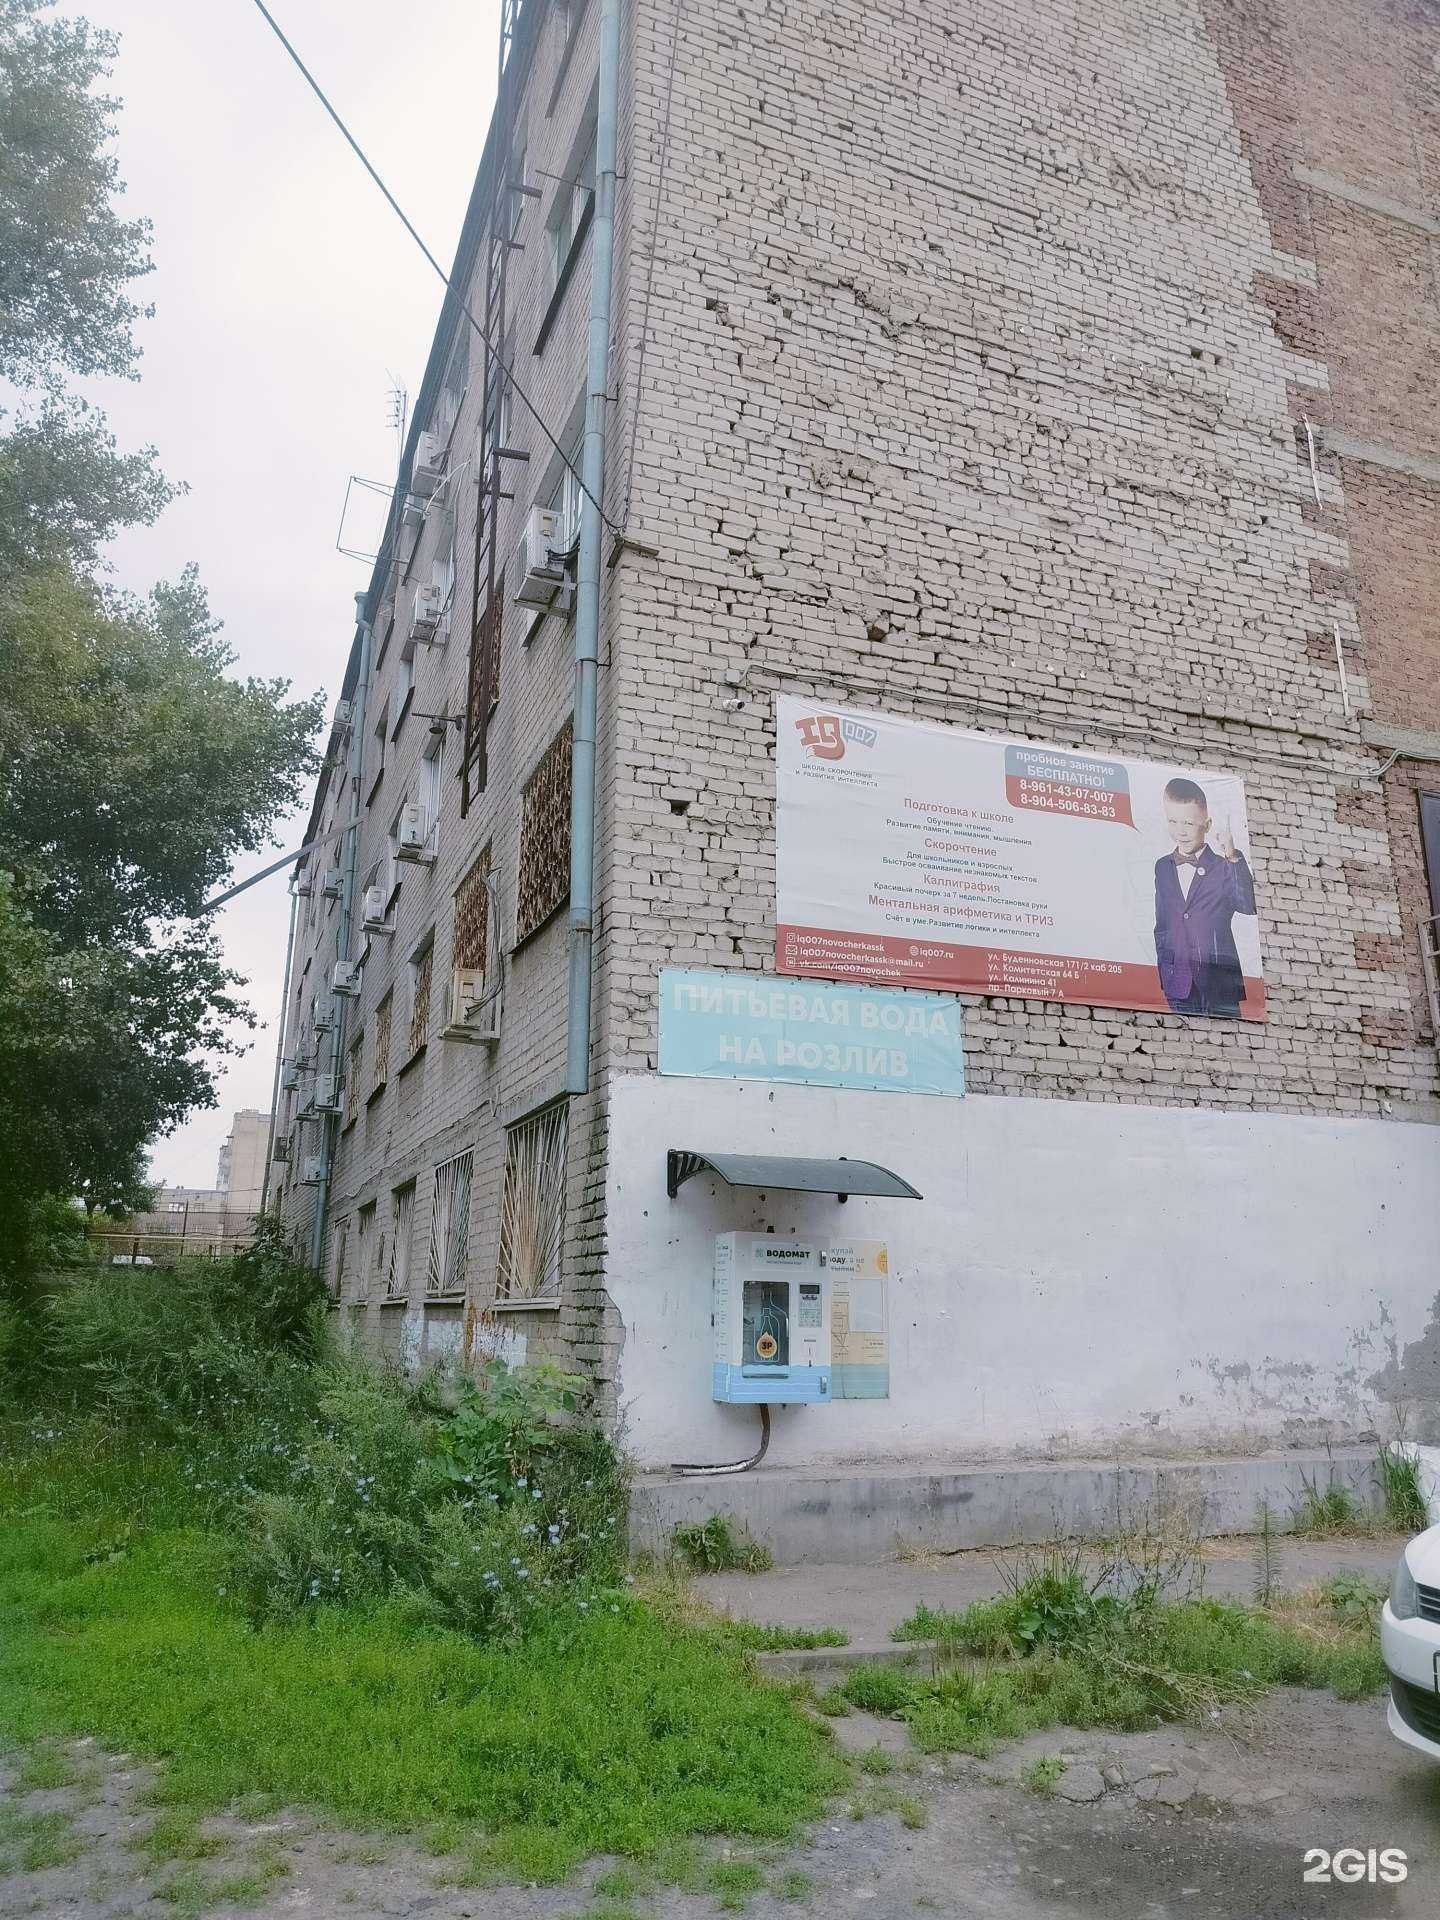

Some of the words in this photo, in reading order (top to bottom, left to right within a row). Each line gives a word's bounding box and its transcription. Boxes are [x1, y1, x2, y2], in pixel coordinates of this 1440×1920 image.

[1016, 752, 1066, 767] пробное
[1070, 760, 1114, 776] занятие
[1027, 765, 1106, 788] БЕСПЛАТНО!
[1020, 779, 1114, 804] 8-961-43-07-007
[904, 798, 968, 817] Подготовка
[971, 810, 978, 818] к
[980, 812, 1014, 824] школе
[1020, 793, 1116, 818] 8-904-506-83-83
[886, 818, 921, 830] Развитие
[994, 835, 1032, 846] мышления
[926, 816, 963, 828] Обучение
[924, 838, 997, 857] Скорочтение
[882, 856, 917, 868] Быстрое
[964, 868, 1008, 879] незнакомых
[906, 851, 922, 860] Для
[924, 854, 969, 866] школьников
[978, 861, 1013, 872] взрослых
[914, 888, 941, 896] почерк
[924, 874, 1000, 894] Каллиграфия
[868, 894, 940, 912] Ментальная
[944, 906, 1012, 921] арифметика
[1024, 914, 1054, 926] ТРИЗ
[965, 924, 990, 932] логики
[999, 928, 1040, 938] интеллекта
[988, 953, 1000, 961] ул.
[1066, 960, 1089, 970] 171/2
[1090, 964, 1106, 972] каб
[1108, 965, 1122, 974] 205
[988, 964, 1000, 972] ул.
[1002, 964, 1061, 978] Комитетская
[988, 974, 1000, 982] ул.
[1003, 974, 1046, 986] Калинина
[1048, 978, 1056, 987] 41
[988, 984, 1002, 992] пр.
[1004, 984, 1049, 997] Парковый
[673, 983, 850, 1027] ПИТЬЕВАЯ
[860, 1003, 950, 1039] ВОДА
[719, 1034, 769, 1066] НА
[776, 1038, 909, 1077] РОЗЛИВ
